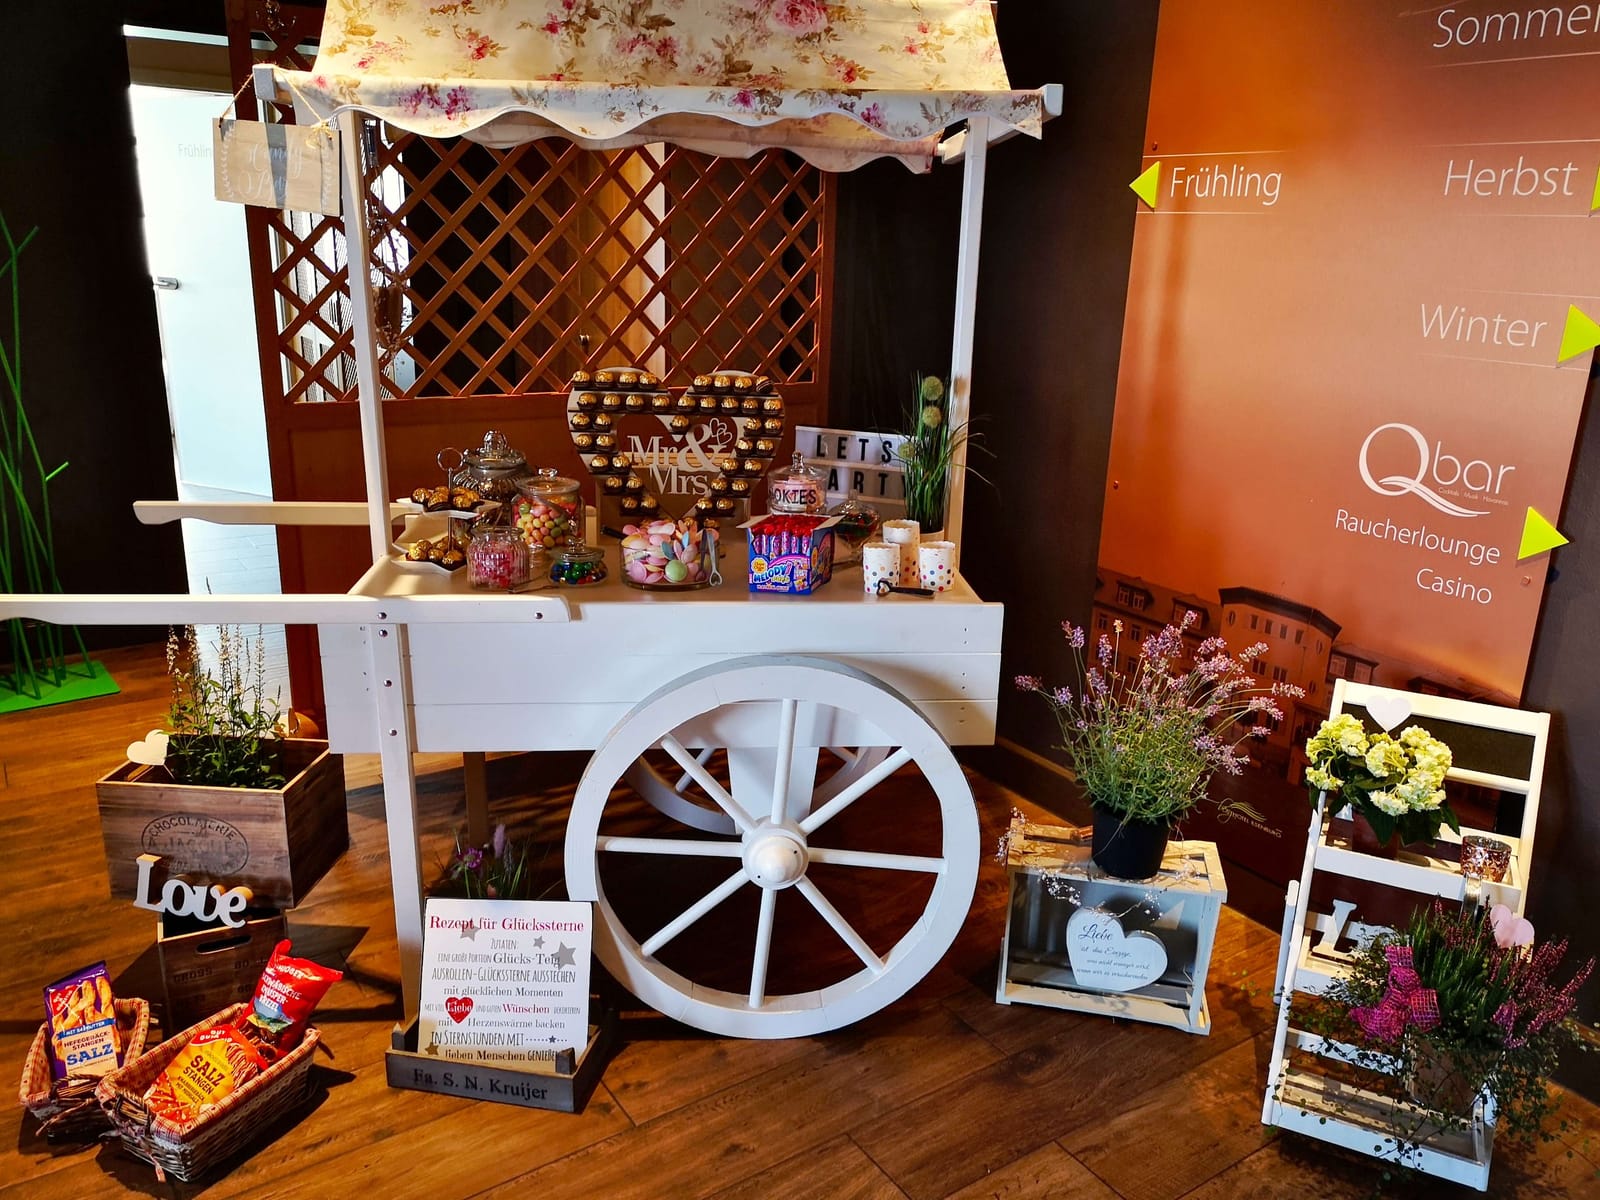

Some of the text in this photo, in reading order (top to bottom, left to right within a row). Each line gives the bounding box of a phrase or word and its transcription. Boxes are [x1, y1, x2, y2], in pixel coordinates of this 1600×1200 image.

[178, 143, 212, 158] Frühlin
[1170, 164, 1283, 206] Frühling
[1443, 156, 1579, 197] Herbst
[1420, 303, 1548, 348] Winter
[816, 434, 893, 463] LETS
[649, 464, 710, 495] Mrs
[1358, 422, 1516, 517] Qbar
[1335, 509, 1501, 566] Raucherlounge
[753, 563, 788, 583] MELODY
[1416, 568, 1492, 604] Casino
[132, 853, 248, 928] Love
[430, 915, 584, 933] Rezept für Glückssterne
[1077, 923, 1113, 943] Liebe
[493, 952, 560, 969] Glücks-Teig
[532, 969, 576, 983] AUSSTECHEN
[443, 985, 564, 997] mit glücklichen Momenten
[447, 1001, 472, 1012] Liebe
[502, 1003, 550, 1014] Wünschen
[438, 1017, 566, 1029] mit Herzenswärme backen
[72, 1038, 105, 1051] STANGEN
[444, 1030, 505, 1046] STERNSTUNDEN
[506, 1032, 524, 1047] MIT
[66, 1043, 114, 1066] SALZ
[445, 1049, 474, 1060] lieben
[476, 1049, 526, 1061] Menschen
[183, 1066, 215, 1095] STANGEN
[190, 1054, 226, 1088] SALZ
[413, 1068, 549, 1101] Fa. S. N. Kruijer
